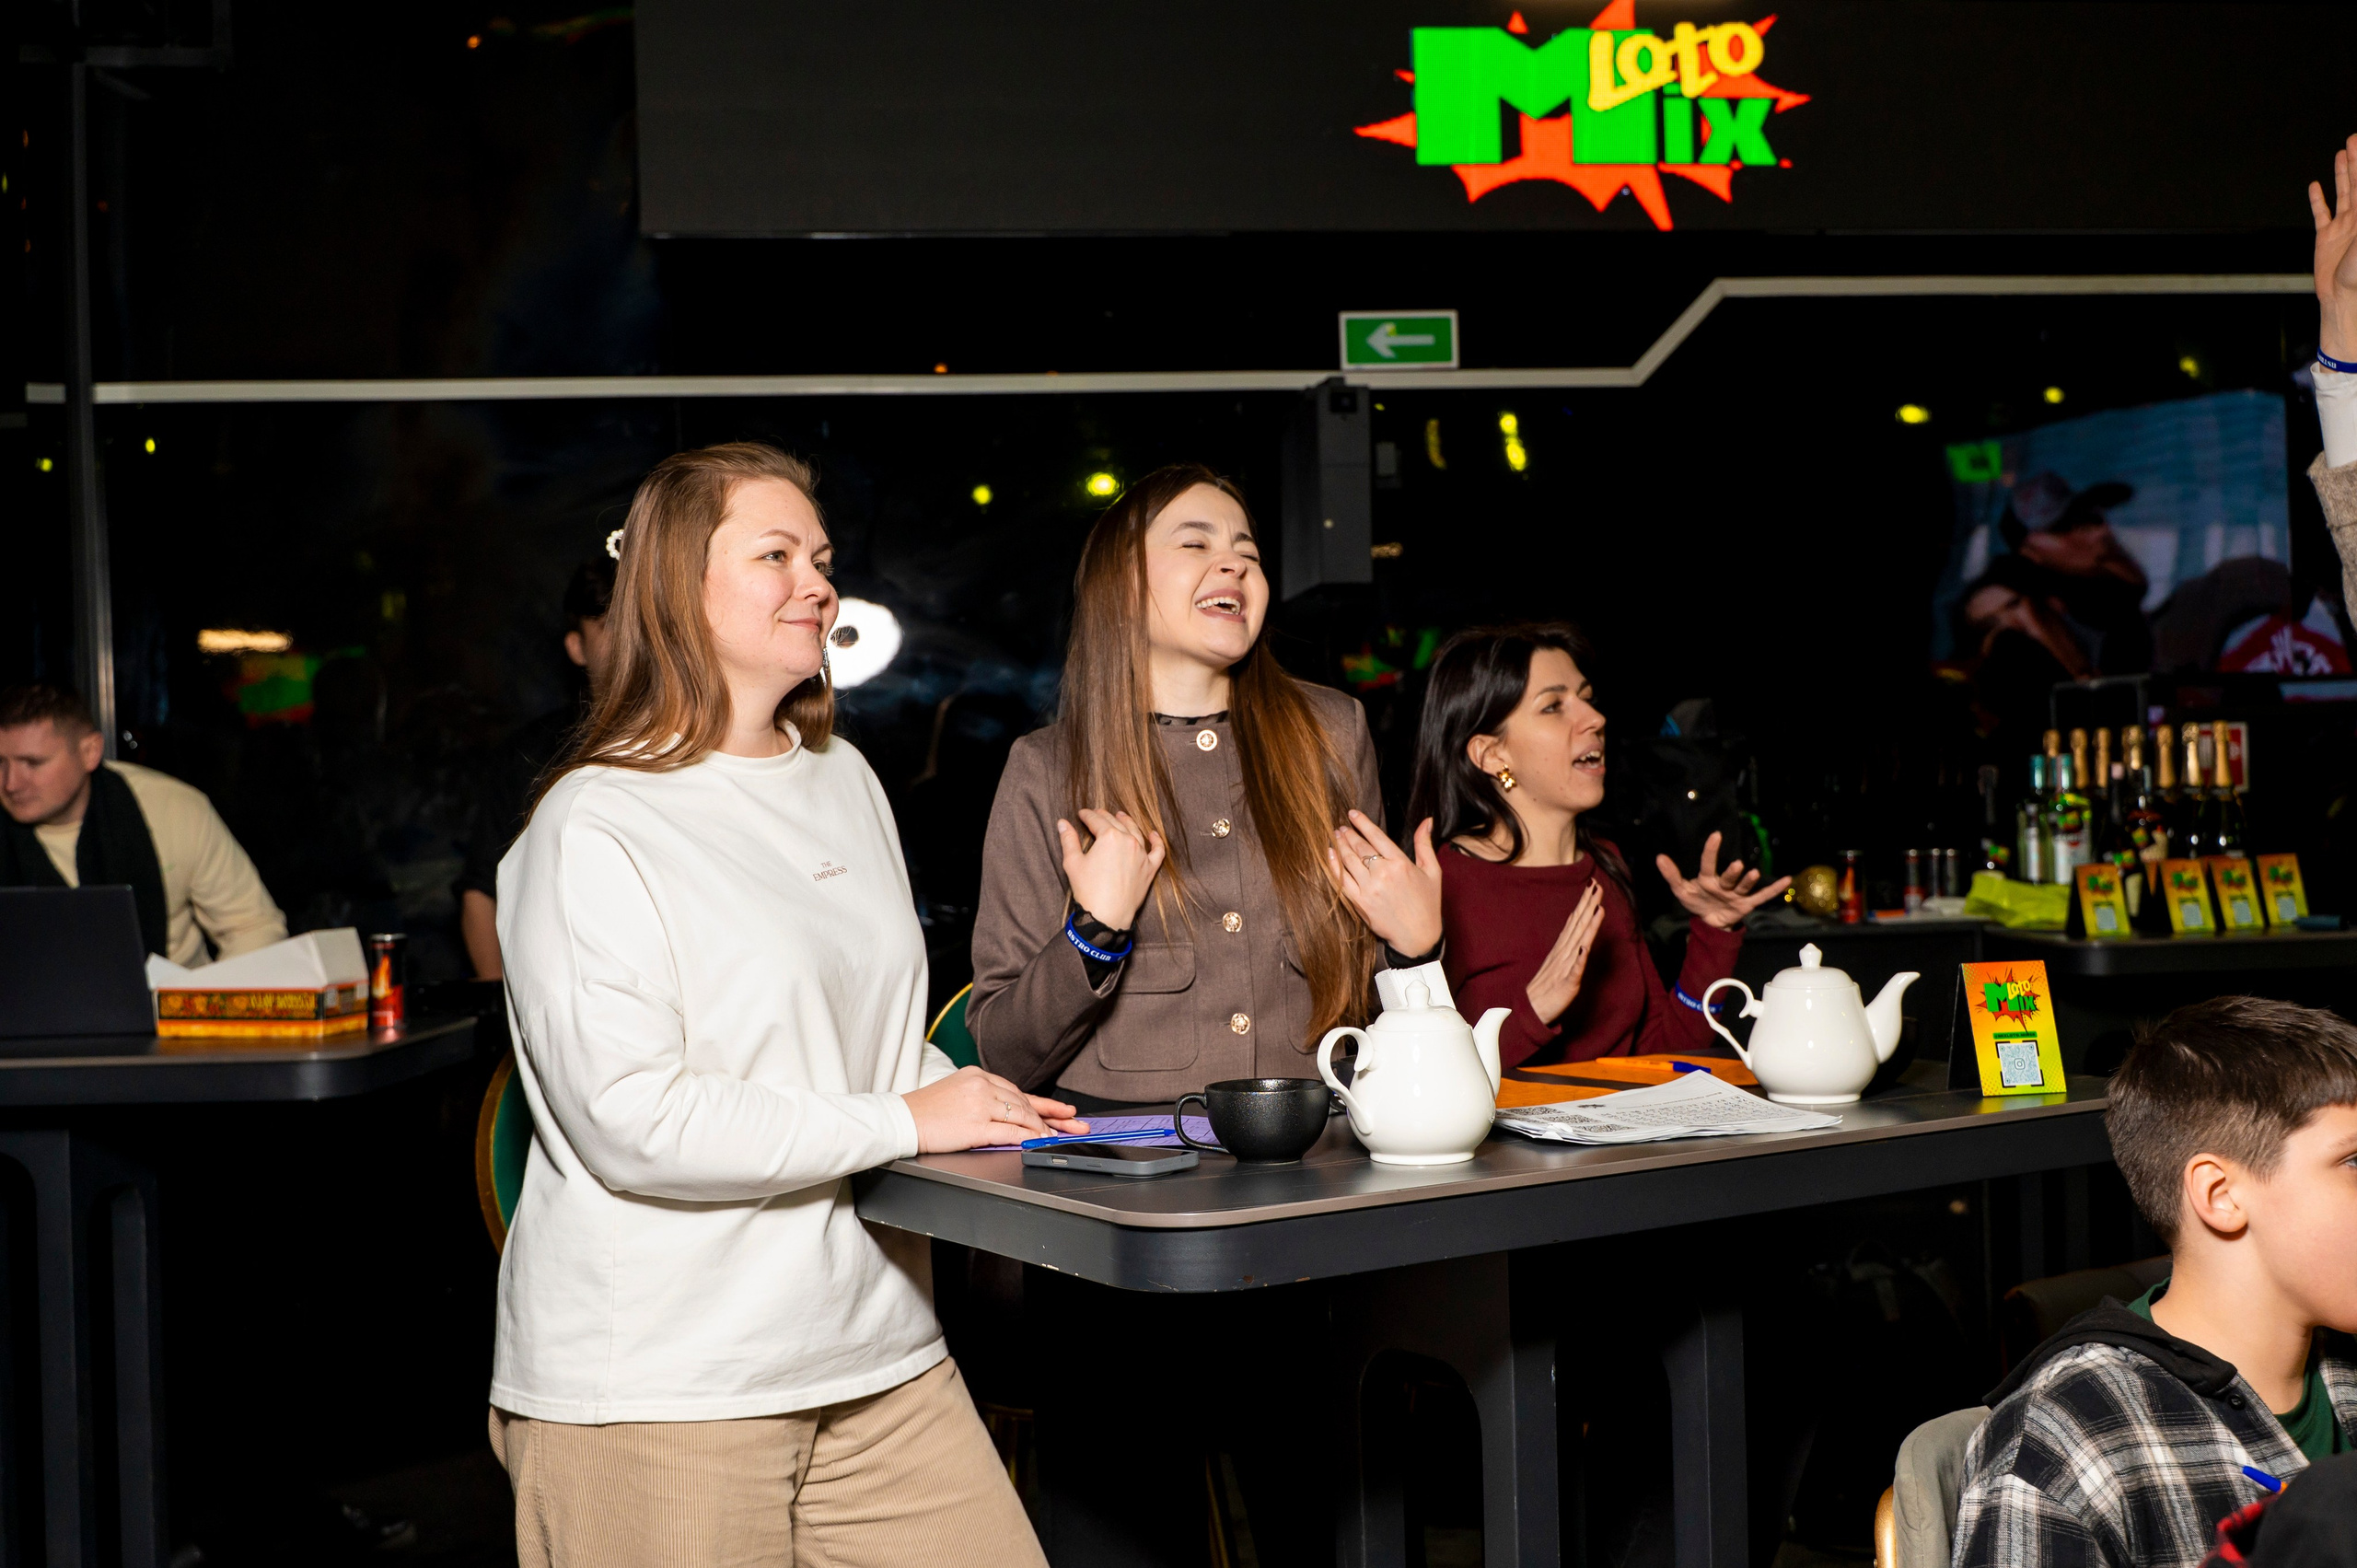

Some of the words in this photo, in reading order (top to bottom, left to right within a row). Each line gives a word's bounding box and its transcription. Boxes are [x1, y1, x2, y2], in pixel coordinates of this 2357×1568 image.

[812, 865, 848, 881] EMPRESS
[1067, 929, 1090, 953] ASTRO
[1090, 950, 1111, 961] CLUB
